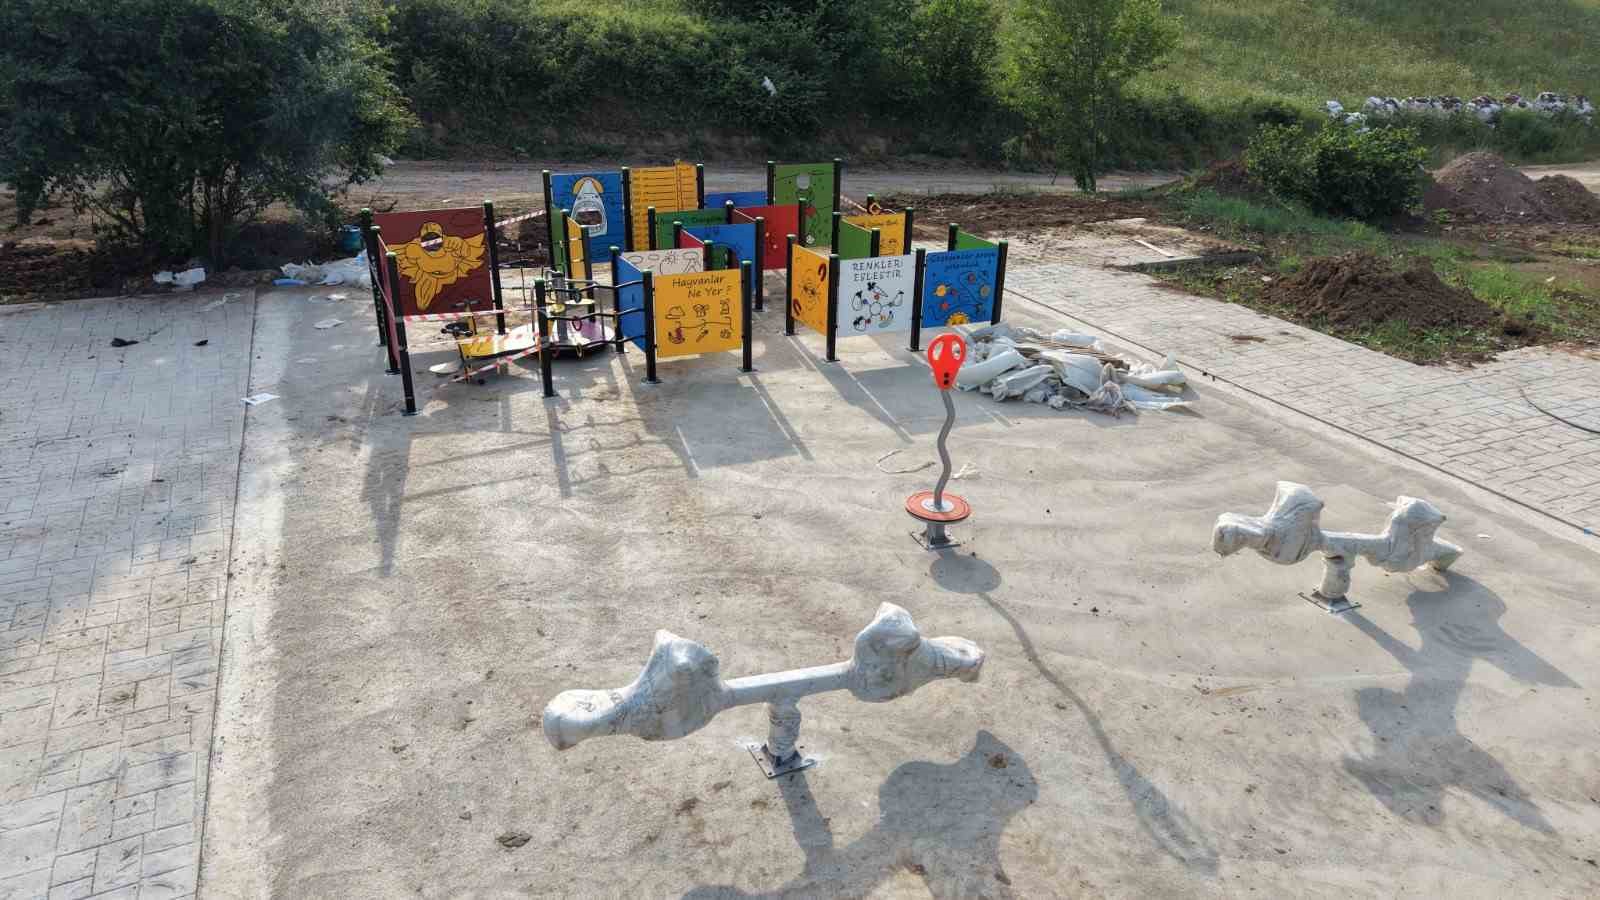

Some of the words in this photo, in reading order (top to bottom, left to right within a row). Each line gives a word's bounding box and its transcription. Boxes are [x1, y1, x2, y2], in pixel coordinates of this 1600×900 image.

[672, 275, 724, 288] Hayvanlar
[688, 288, 702, 298] Ne
[705, 287, 722, 296] Yer
